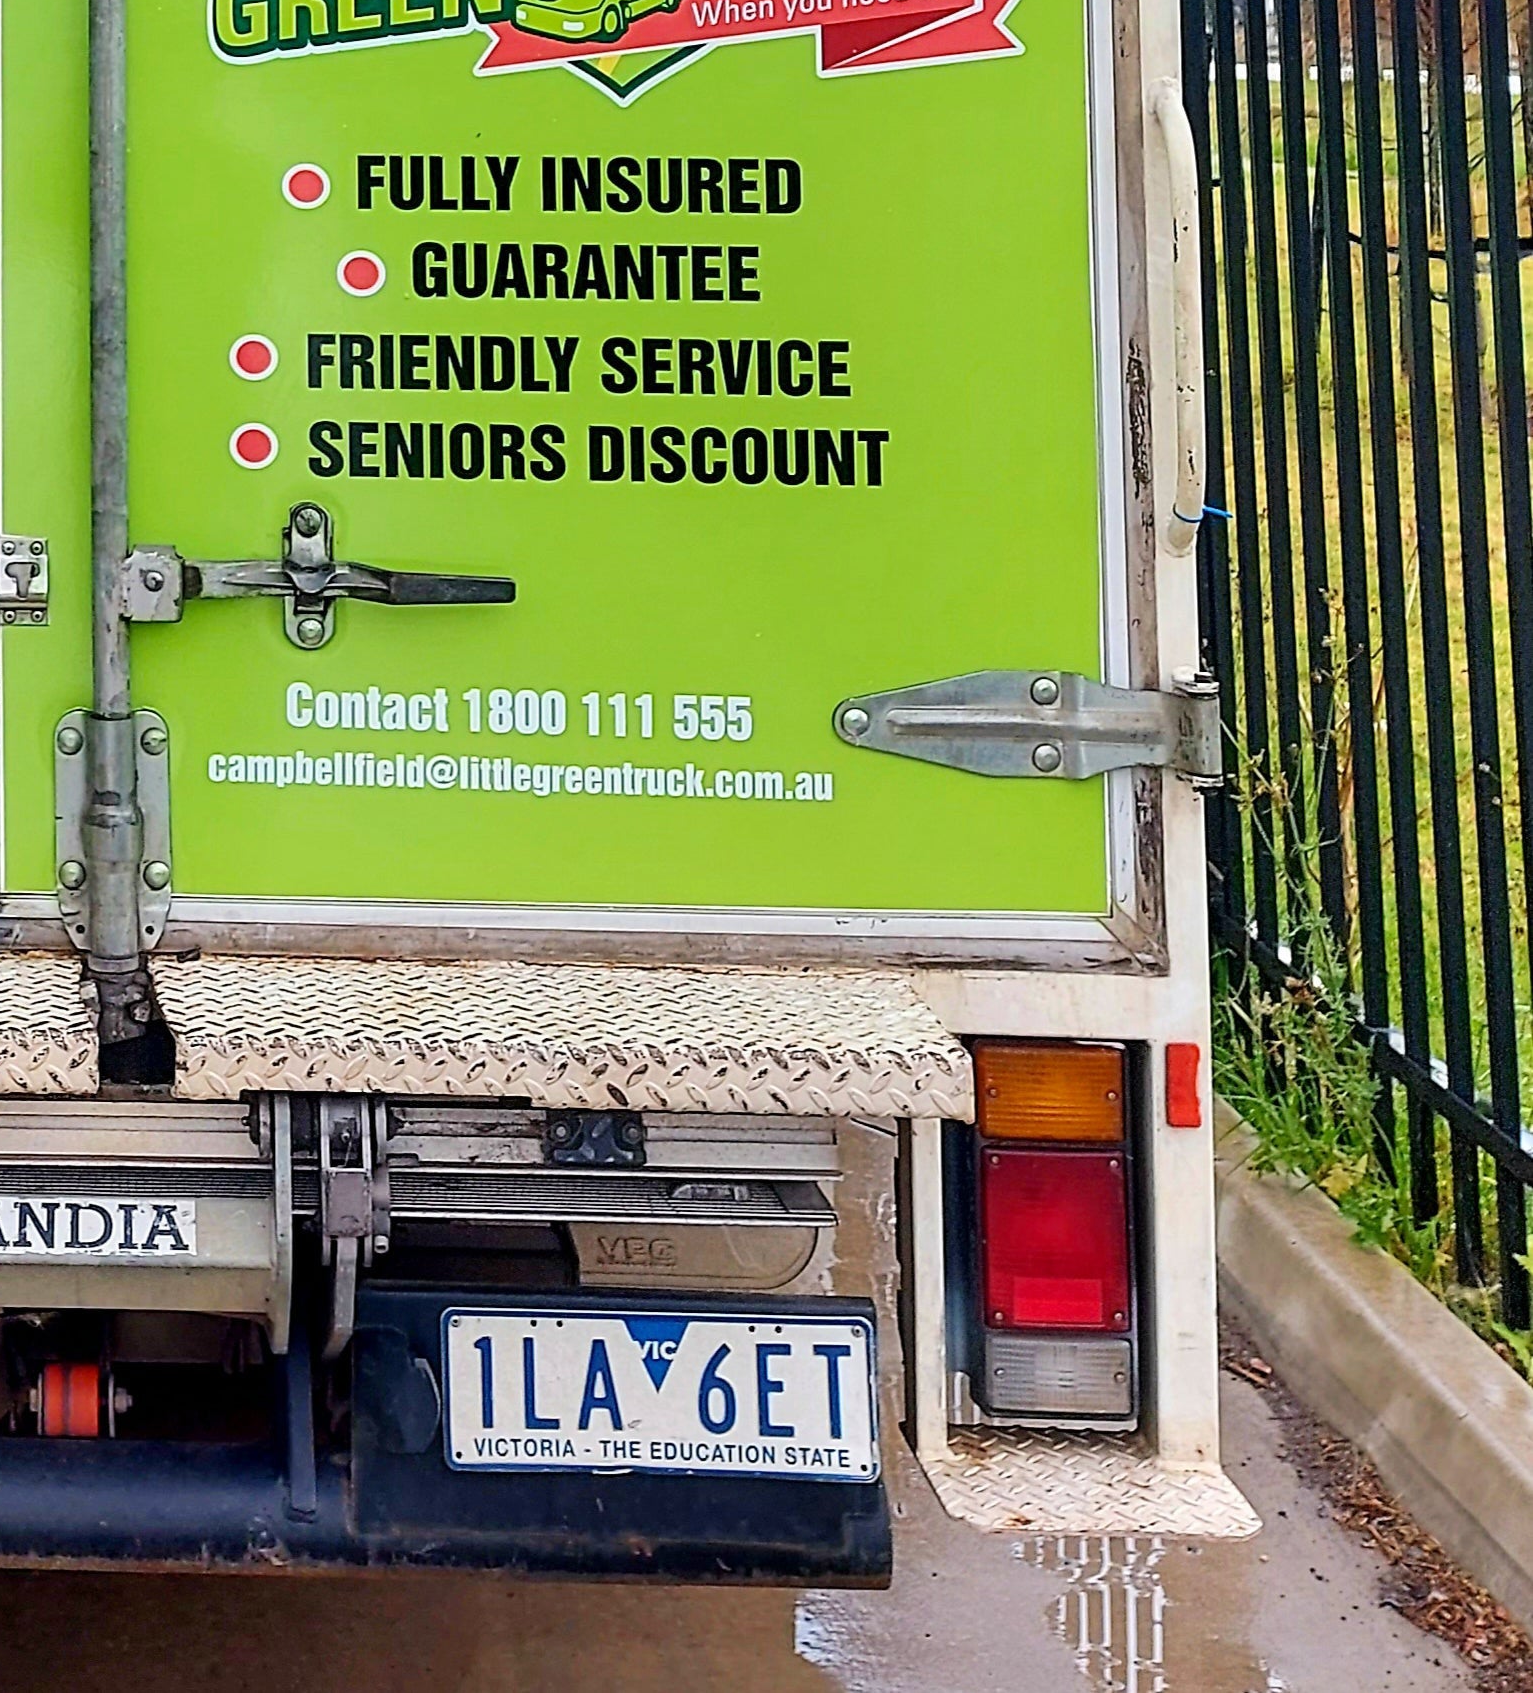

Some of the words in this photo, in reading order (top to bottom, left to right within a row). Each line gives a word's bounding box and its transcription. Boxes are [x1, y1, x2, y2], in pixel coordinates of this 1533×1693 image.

[356, 154, 520, 212] FULLY
[541, 155, 802, 215] INSURED
[411, 241, 761, 302] GUARANTEE
[306, 332, 579, 393] FRIENDLY
[601, 337, 852, 397] SERVICE
[307, 420, 566, 482] SENIORS
[587, 424, 890, 487] DISCOUNT
[286, 681, 449, 733] Contact
[462, 687, 567, 736] 1800
[582, 691, 655, 739] 111
[673, 693, 754, 742] 555
[208, 749, 834, 802] campbellfield@littlegreentruck.com.au
[634, 1340, 677, 1361] VIC
[474, 1437, 576, 1458] VICTORIA
[599, 1440, 640, 1460] THE
[649, 1442, 776, 1465] EDUCATION
[785, 1447, 851, 1468] STATE
